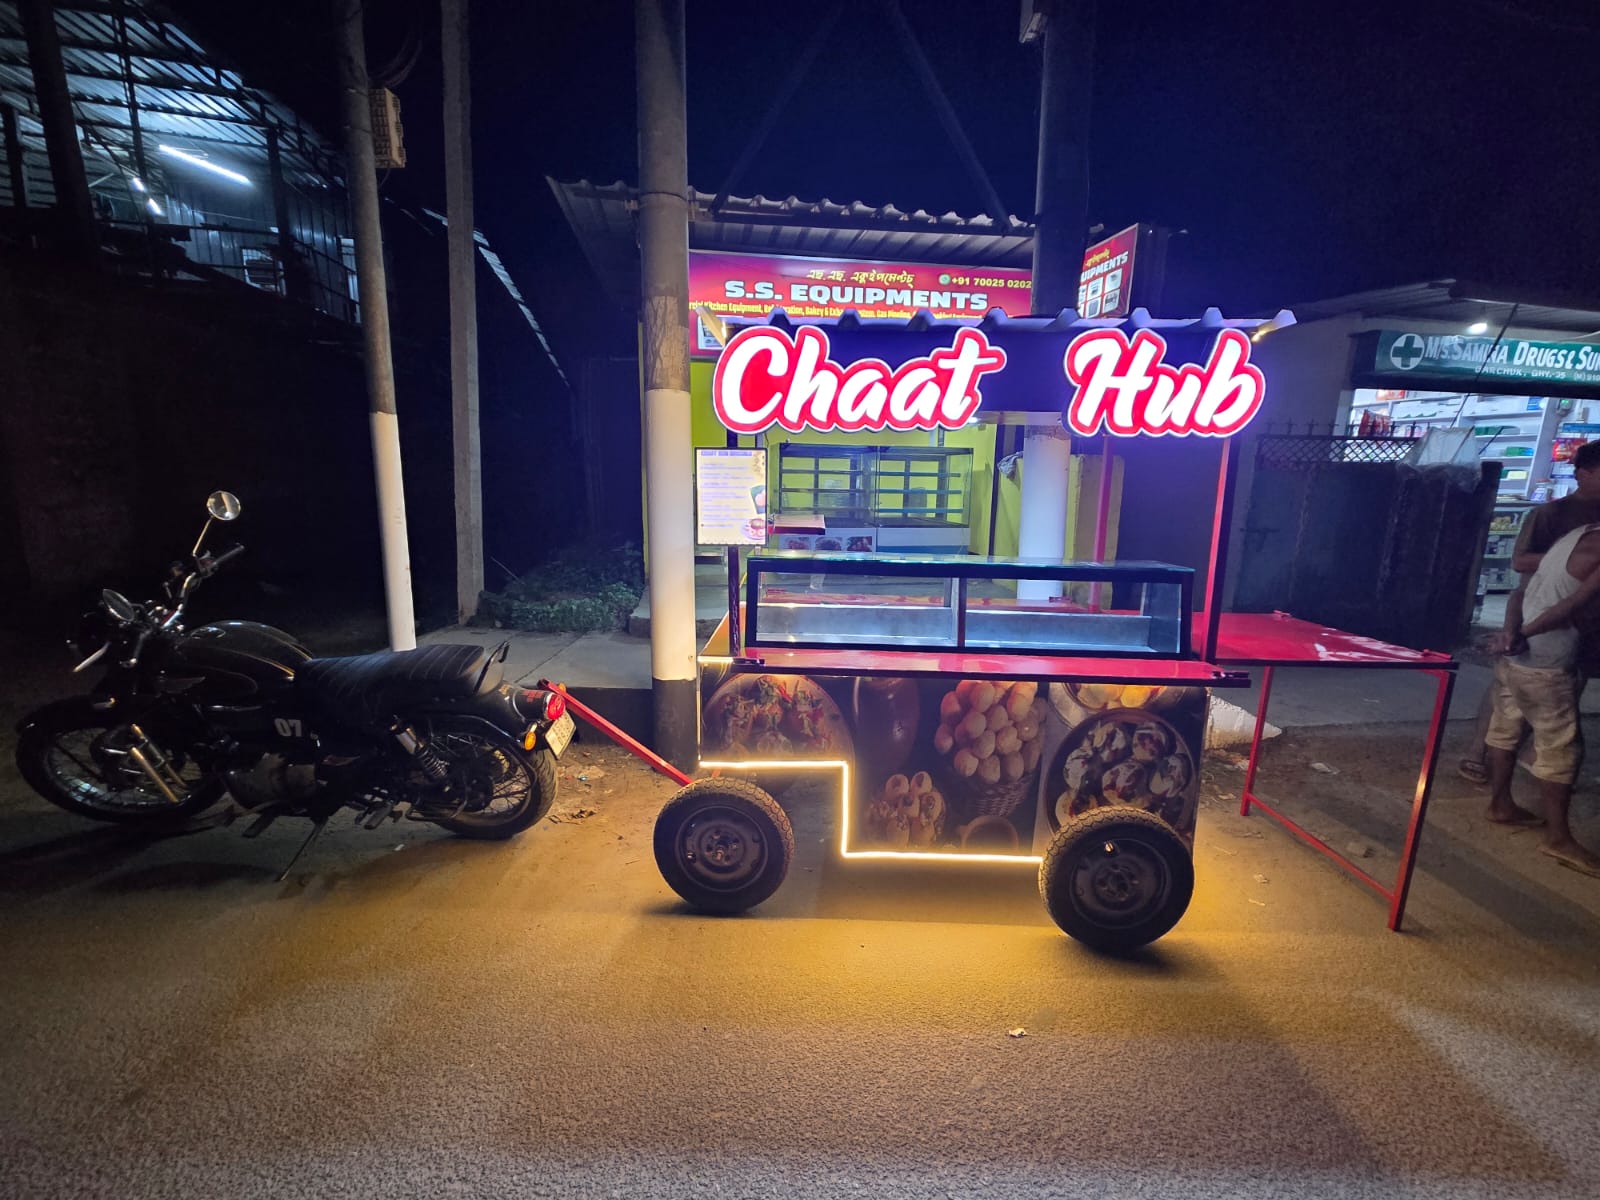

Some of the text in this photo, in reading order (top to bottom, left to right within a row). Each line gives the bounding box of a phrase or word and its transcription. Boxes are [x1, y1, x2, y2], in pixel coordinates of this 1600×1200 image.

[952, 277, 1032, 288] +91 70025 0202
[1080, 251, 1129, 283] UIPMENTS
[725, 280, 988, 311] S.S. EQUIPMENTS
[713, 325, 1266, 437] Chaat Hub
[274, 718, 302, 737] 07
